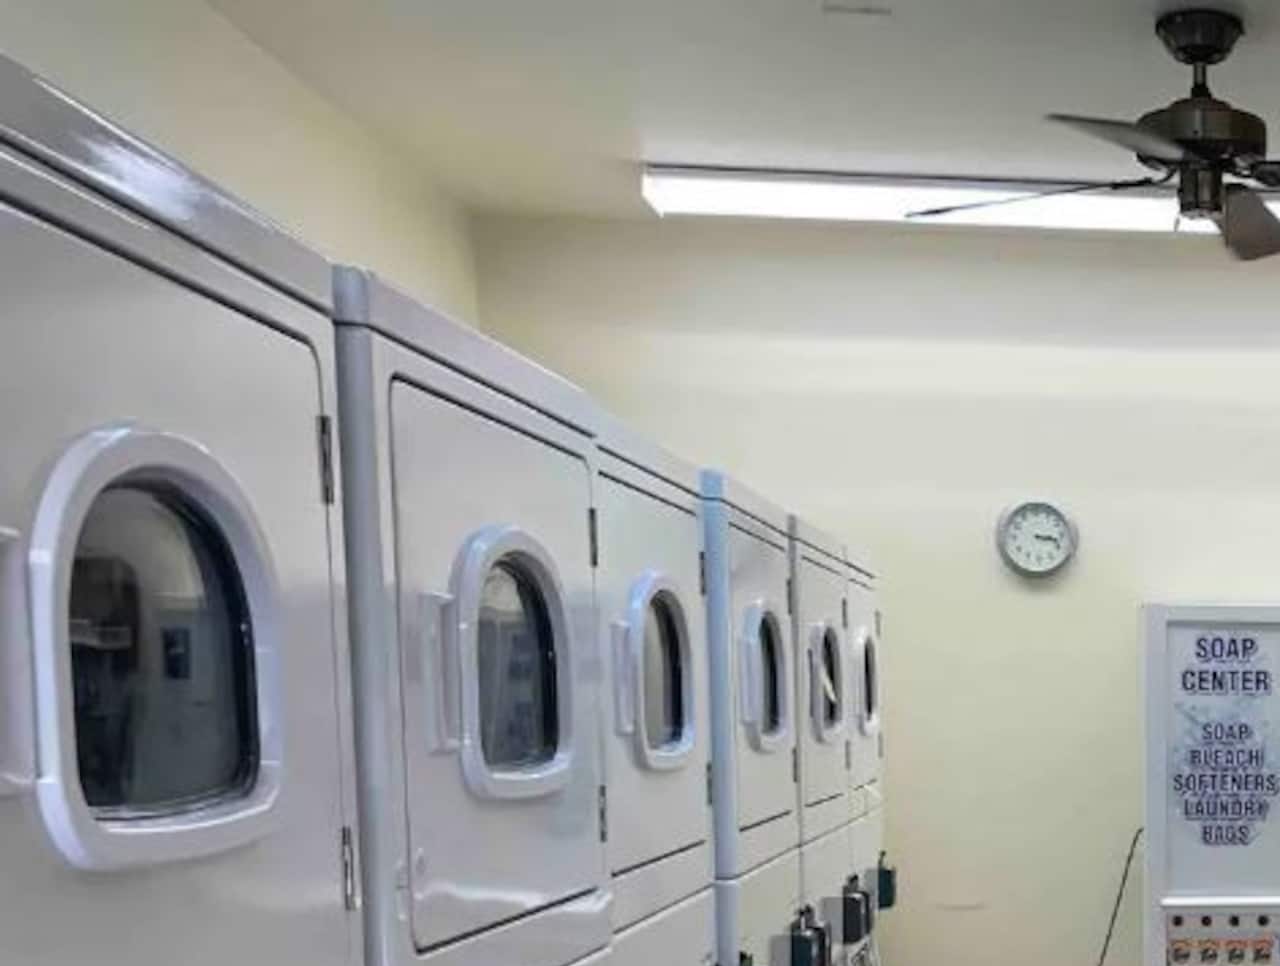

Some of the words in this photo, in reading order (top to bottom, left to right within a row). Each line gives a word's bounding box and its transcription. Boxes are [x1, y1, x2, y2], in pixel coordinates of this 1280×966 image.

[1195, 637, 1256, 659] SOAP
[1181, 669, 1269, 692] CENTER
[1202, 722, 1250, 741] SOAP
[1188, 749, 1261, 767] BLEACH
[1172, 773, 1277, 792] SOFTENERS
[1184, 798, 1266, 817] LAUNDRY
[1203, 825, 1250, 844] BAGS
